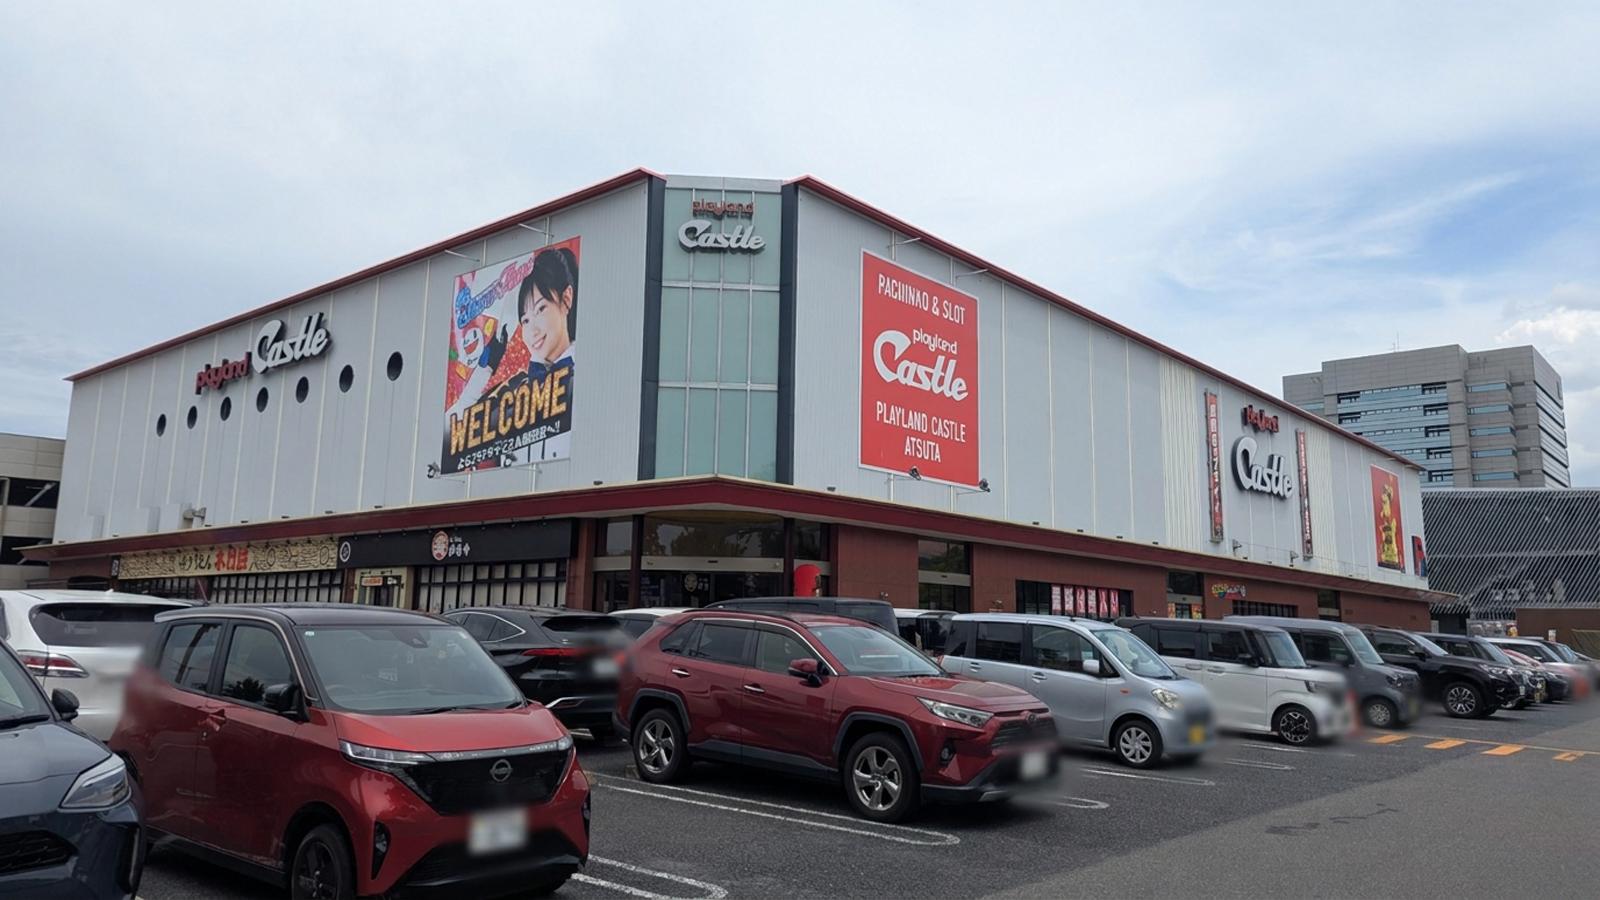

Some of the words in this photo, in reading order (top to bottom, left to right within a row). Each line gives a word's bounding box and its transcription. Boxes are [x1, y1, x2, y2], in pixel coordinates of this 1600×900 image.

[678, 219, 766, 252] Castle
[931, 296, 940, 316] &
[942, 300, 965, 325] SLOT
[252, 312, 331, 374] Castle
[873, 330, 968, 401] Castle
[450, 366, 569, 456] WELCOME
[876, 401, 928, 433] PLAYLAND
[931, 416, 966, 443] CASTLE
[904, 435, 941, 463] ATSUTA
[1231, 435, 1294, 499] Castle
